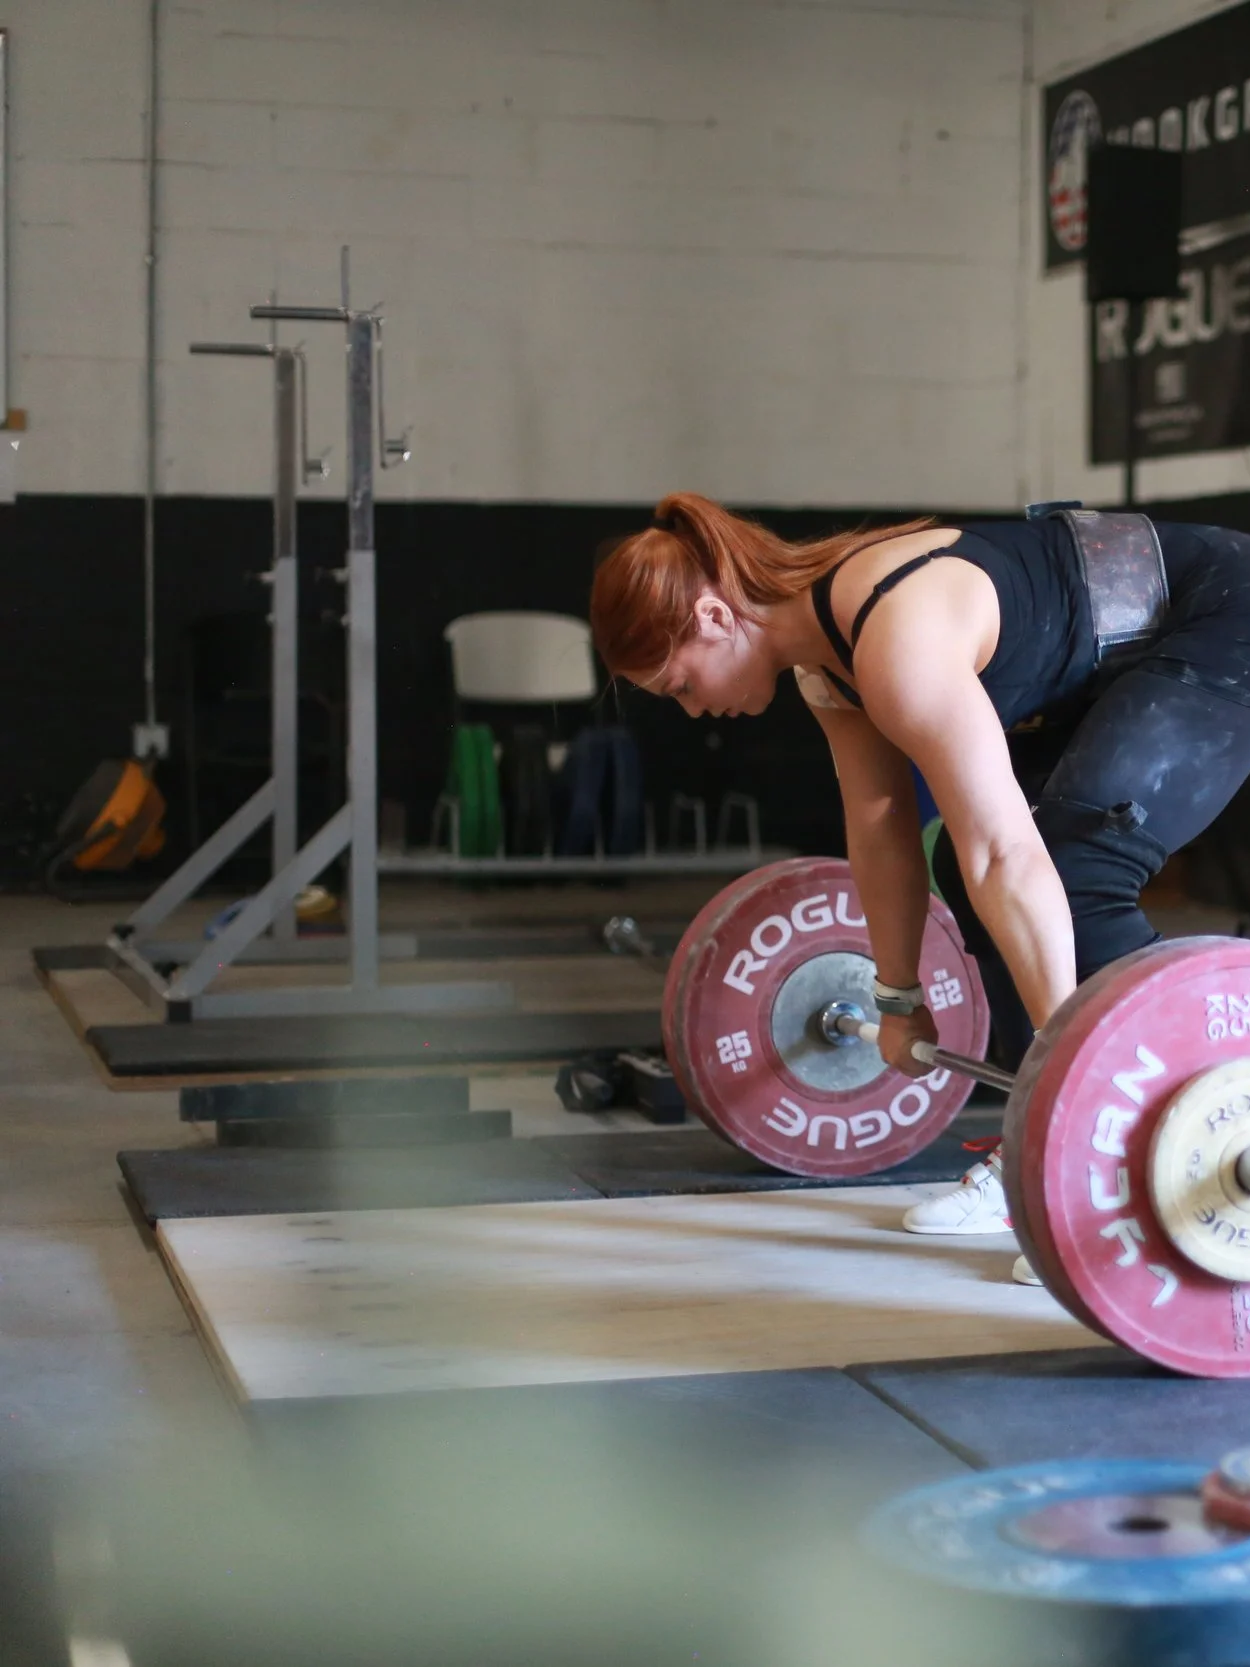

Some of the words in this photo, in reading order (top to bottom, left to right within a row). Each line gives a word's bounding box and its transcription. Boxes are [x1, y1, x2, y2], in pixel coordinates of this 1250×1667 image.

[723, 892, 868, 996] ROGU
[928, 977, 964, 1012] 25
[716, 1031, 752, 1065] 25
